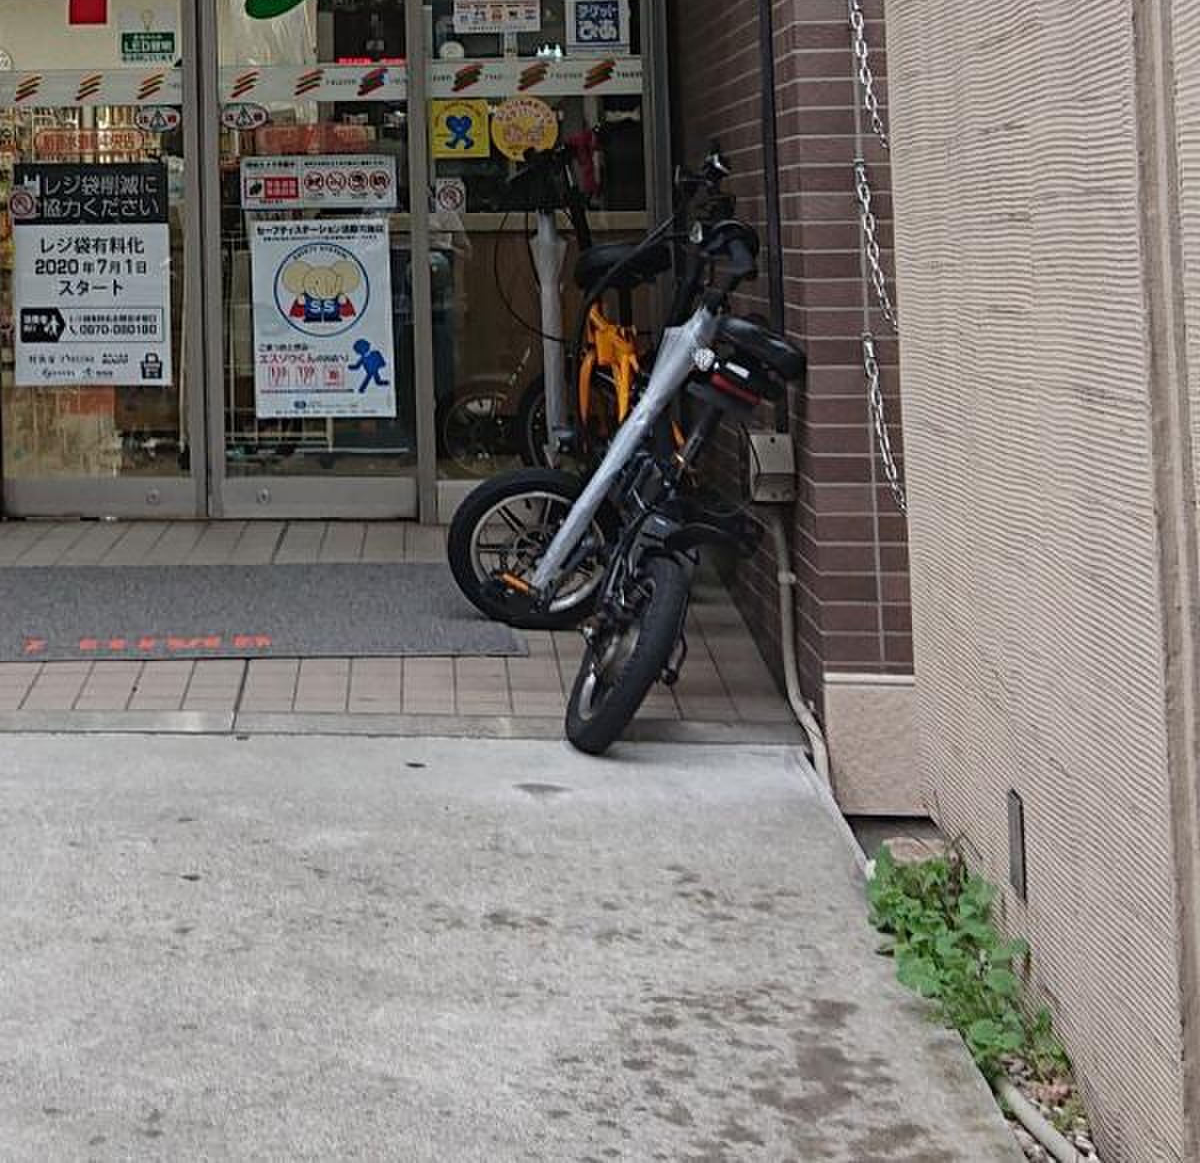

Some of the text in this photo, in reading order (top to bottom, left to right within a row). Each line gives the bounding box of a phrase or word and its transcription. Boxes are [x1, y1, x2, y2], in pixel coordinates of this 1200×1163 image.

[44, 174, 158, 196] レジ袋削減に
[35, 197, 160, 218] 協力ください
[40, 237, 145, 254] レジ袋有料化
[35, 258, 147, 275] 2020年7月1日
[58, 279, 124, 297] スタート
